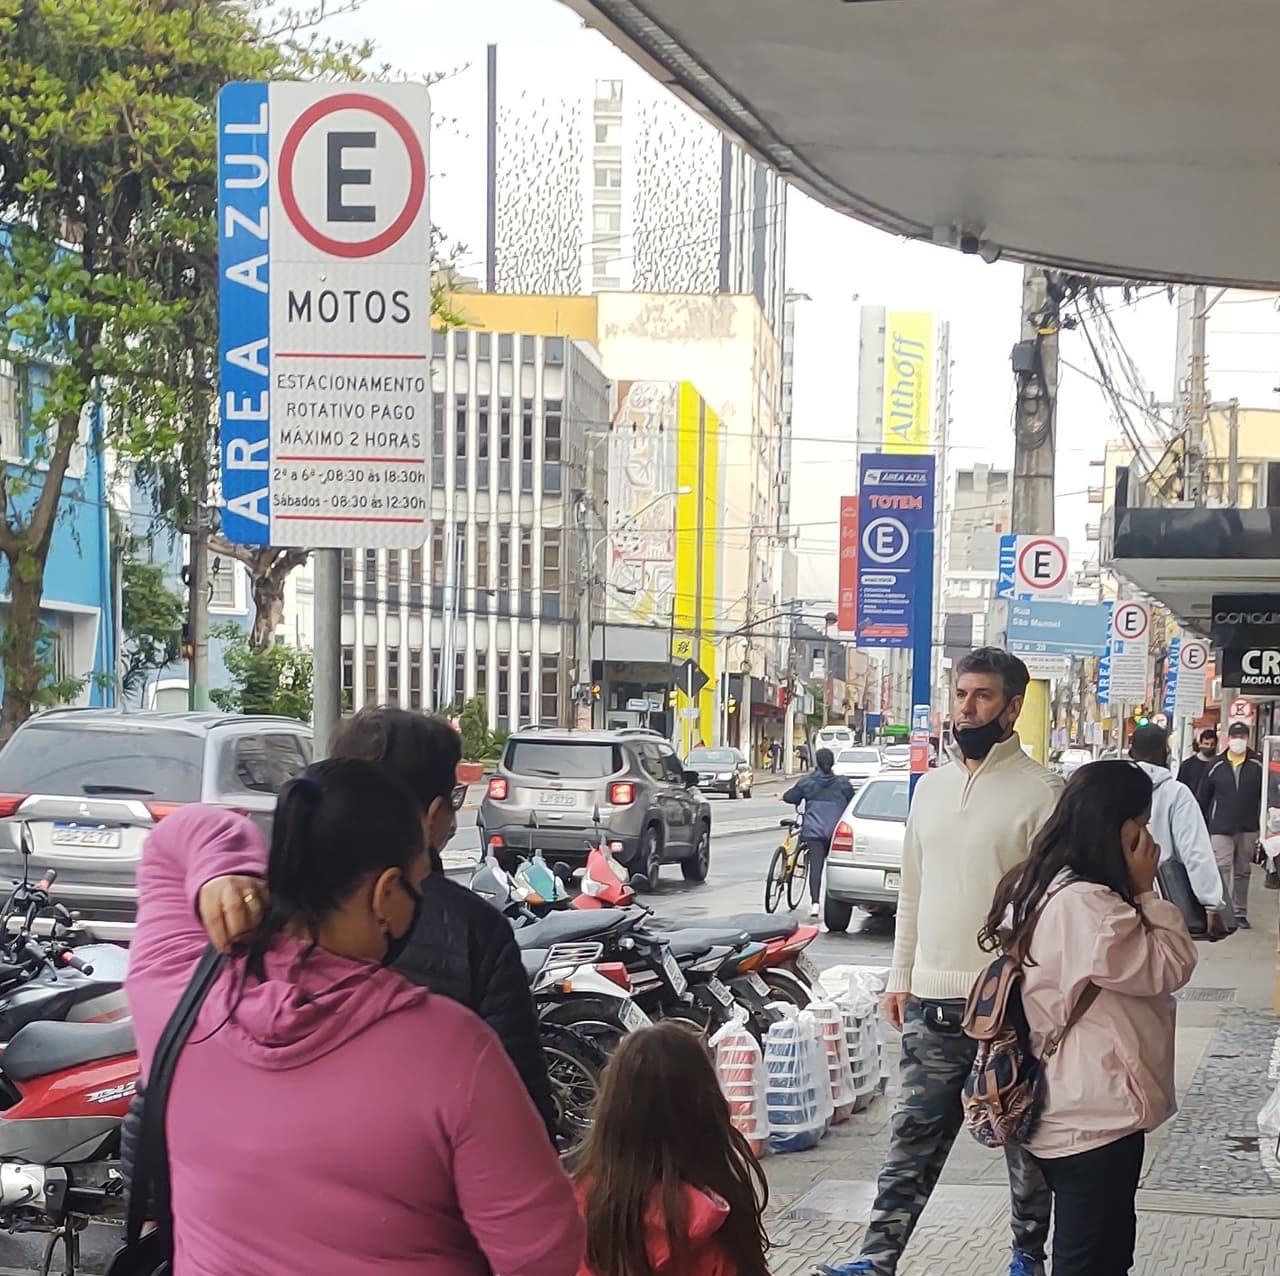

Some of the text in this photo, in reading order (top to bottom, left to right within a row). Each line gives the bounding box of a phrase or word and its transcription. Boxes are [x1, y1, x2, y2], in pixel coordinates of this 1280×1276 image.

[326, 131, 377, 223] E
[224, 102, 270, 526] AREA AZUL
[287, 289, 412, 325] MOTOS
[276, 374, 426, 393] ESTACIONAMENTO
[889, 331, 926, 442] Althoff
[286, 402, 416, 420] ROTATIVO PAGO
[280, 425, 421, 448] MÁXIMO 2 HORAS
[326, 469, 364, 482] 08:30
[384, 469, 426, 483] 18:30h
[272, 493, 321, 507] Sábados
[331, 494, 368, 508] 08:30
[386, 495, 426, 510] 12:30h
[868, 495, 923, 510] TOTEM
[876, 526, 894, 555] E
[999, 540, 1017, 601] AZUL
[1033, 550, 1052, 578] E
[1125, 611, 1138, 632] E
[1188, 648, 1199, 664] E
[1099, 656, 1112, 699] AREA
[1165, 641, 1181, 712] AREA AZUL
[1241, 675, 1272, 685] MODA
